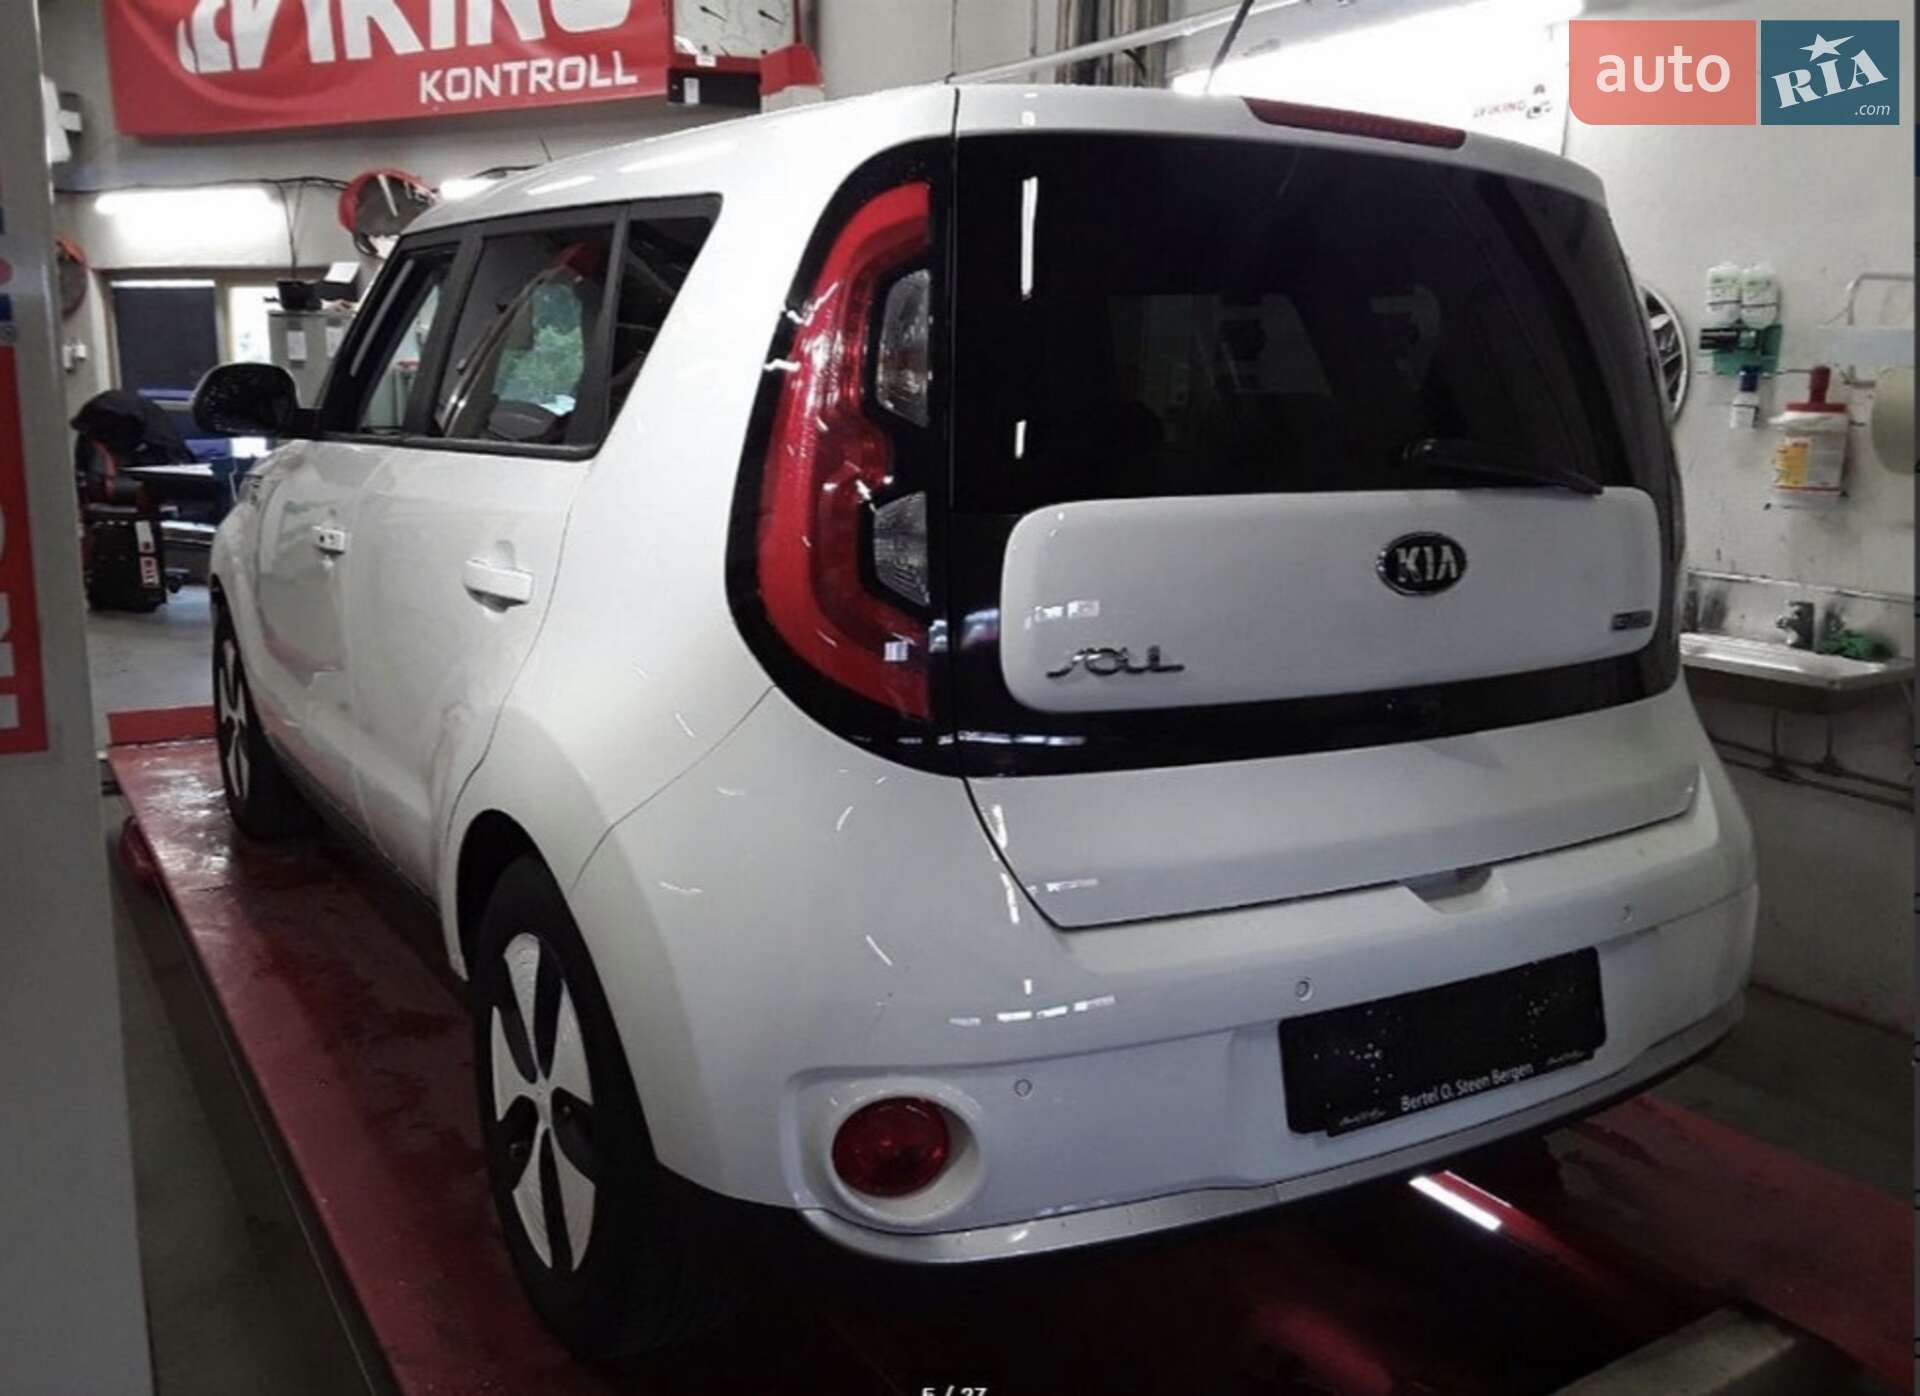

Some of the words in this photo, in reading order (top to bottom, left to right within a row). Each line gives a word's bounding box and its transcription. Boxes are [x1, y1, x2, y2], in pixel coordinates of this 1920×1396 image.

[418, 51, 638, 103] KONTROLL
[1396, 546, 1458, 582] KIA
[1046, 645, 1185, 678] SOUL
[1401, 1087, 1440, 1111] Bertel
[1457, 1074, 1490, 1097] Steen
[1491, 1062, 1534, 1084] Bergen
